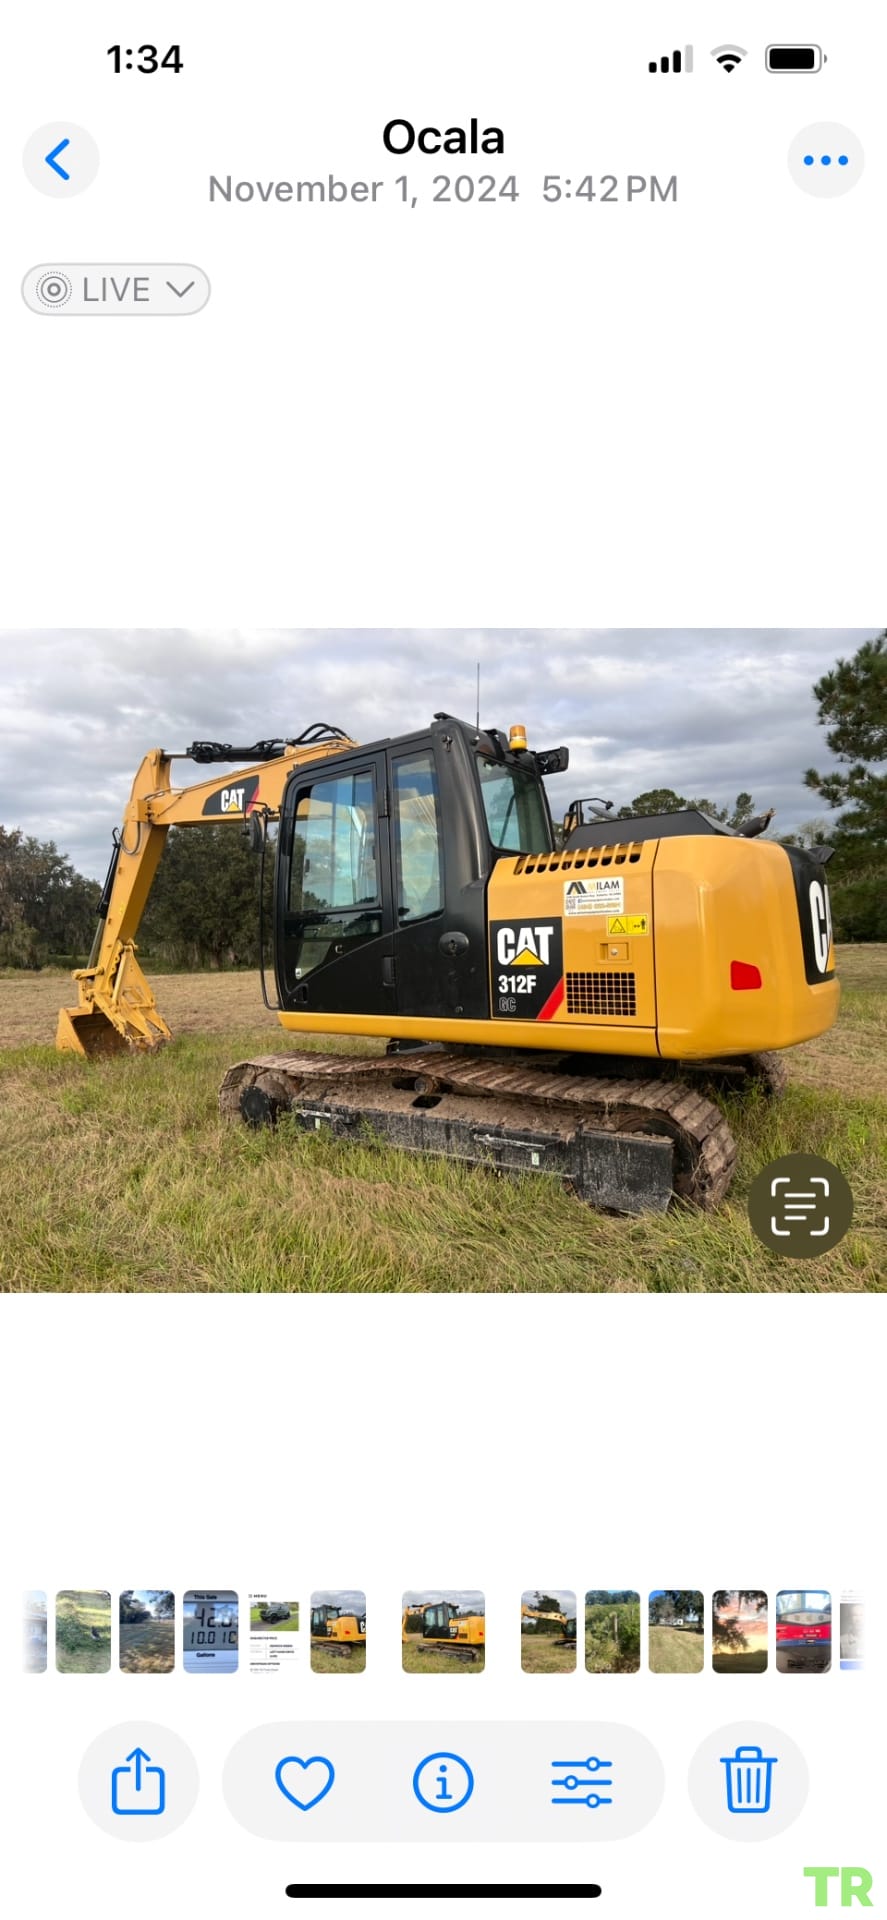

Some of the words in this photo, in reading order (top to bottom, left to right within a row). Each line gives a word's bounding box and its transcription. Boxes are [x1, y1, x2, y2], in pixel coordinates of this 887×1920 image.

[107, 44, 184, 74] 1:34
[383, 118, 504, 155] Ocala
[210, 174, 384, 203] November
[395, 175, 417, 208] 1,
[433, 175, 519, 203] 2024
[543, 175, 618, 203] 5:42
[627, 175, 677, 203] PM
[83, 276, 150, 302] LIVE
[221, 788, 245, 812] CAT
[497, 926, 554, 966] CAT
[498, 975, 537, 994] 312F
[499, 997, 516, 1012] GC
